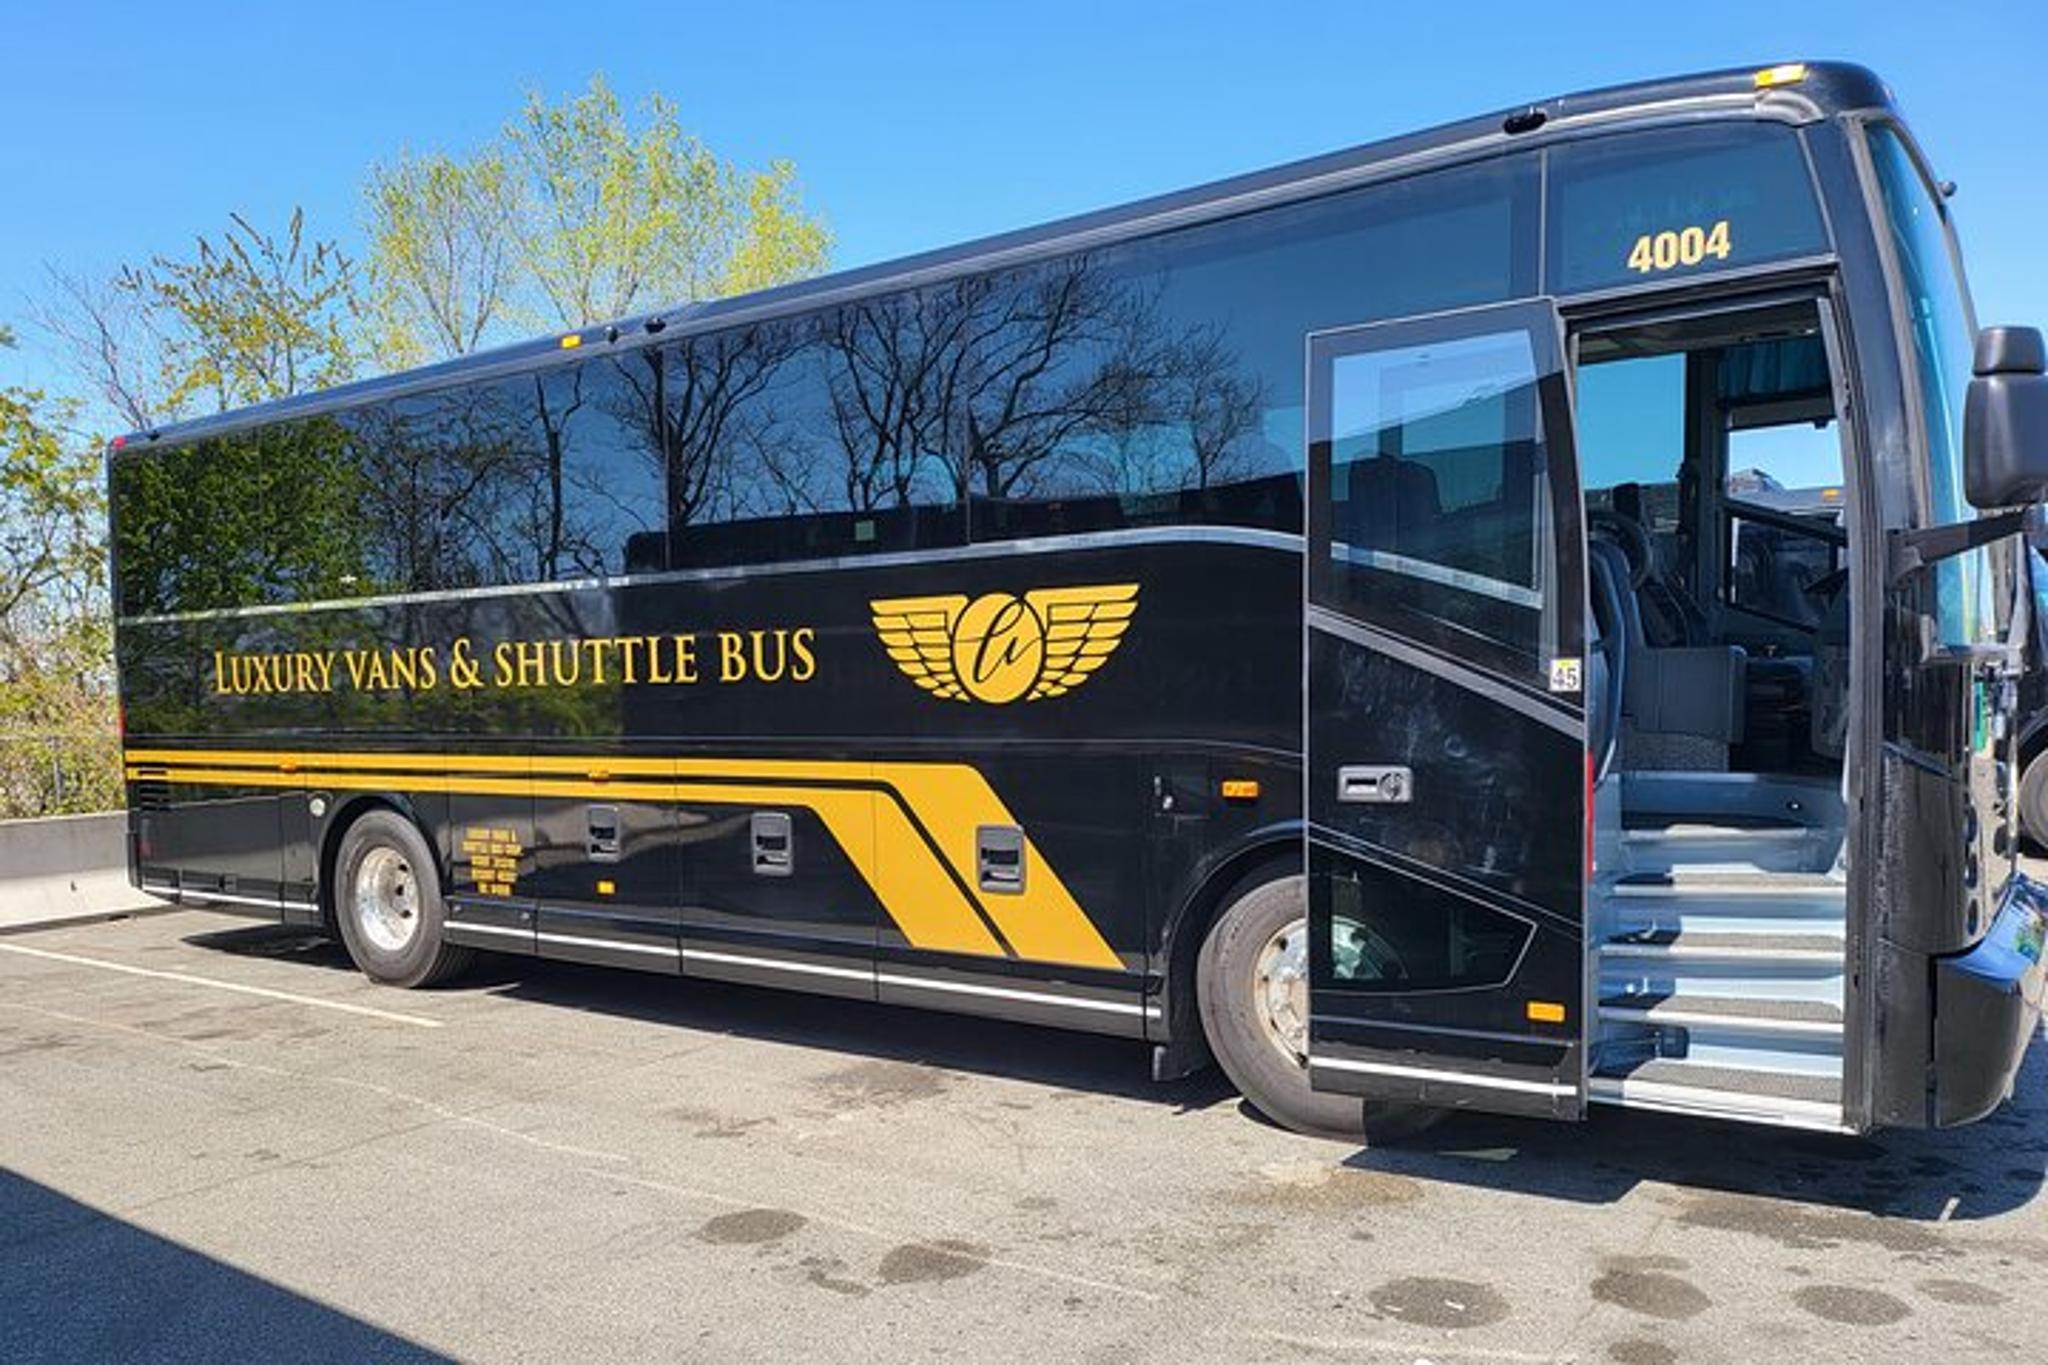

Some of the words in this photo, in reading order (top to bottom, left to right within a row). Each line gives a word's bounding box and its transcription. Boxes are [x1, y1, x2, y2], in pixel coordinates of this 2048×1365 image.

[1627, 220, 1732, 274] 4004
[213, 650, 336, 695] LUXURY
[343, 647, 437, 691] VANS
[450, 637, 486, 690] &
[495, 633, 699, 687] SHUTTLE
[718, 627, 818, 682] BUS
[1552, 667, 1577, 689] 45
